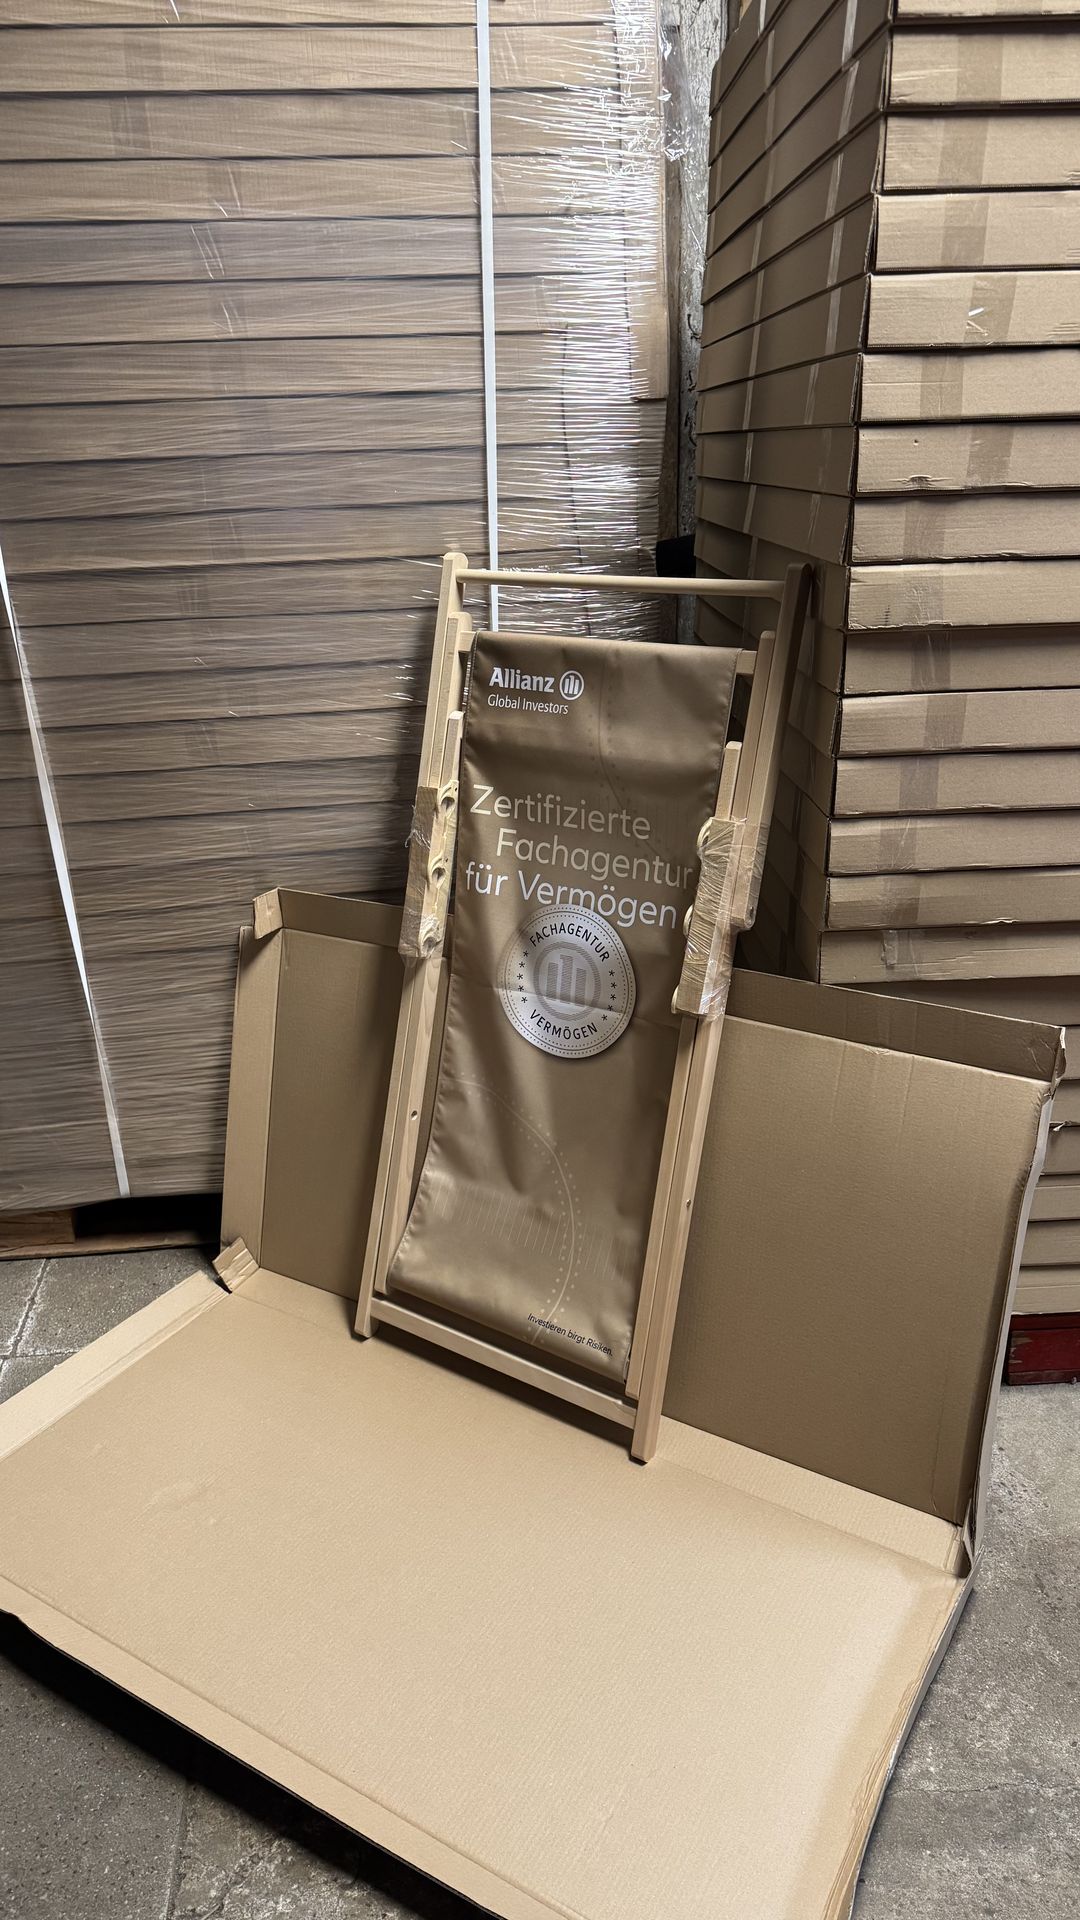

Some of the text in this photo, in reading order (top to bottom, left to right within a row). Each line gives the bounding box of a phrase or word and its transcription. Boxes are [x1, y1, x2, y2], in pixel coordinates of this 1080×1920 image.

[488, 667, 555, 693] Allianz
[487, 694, 569, 715] Global Investors
[470, 784, 651, 840] Zertifizierte
[496, 828, 693, 889] Fachagentur
[465, 861, 677, 929] für Vermögen
[529, 922, 610, 962] FACHAGENTUR
[530, 1009, 598, 1040] VERMÖGEN
[528, 1313, 613, 1356] Investieren birgt Risiken.
